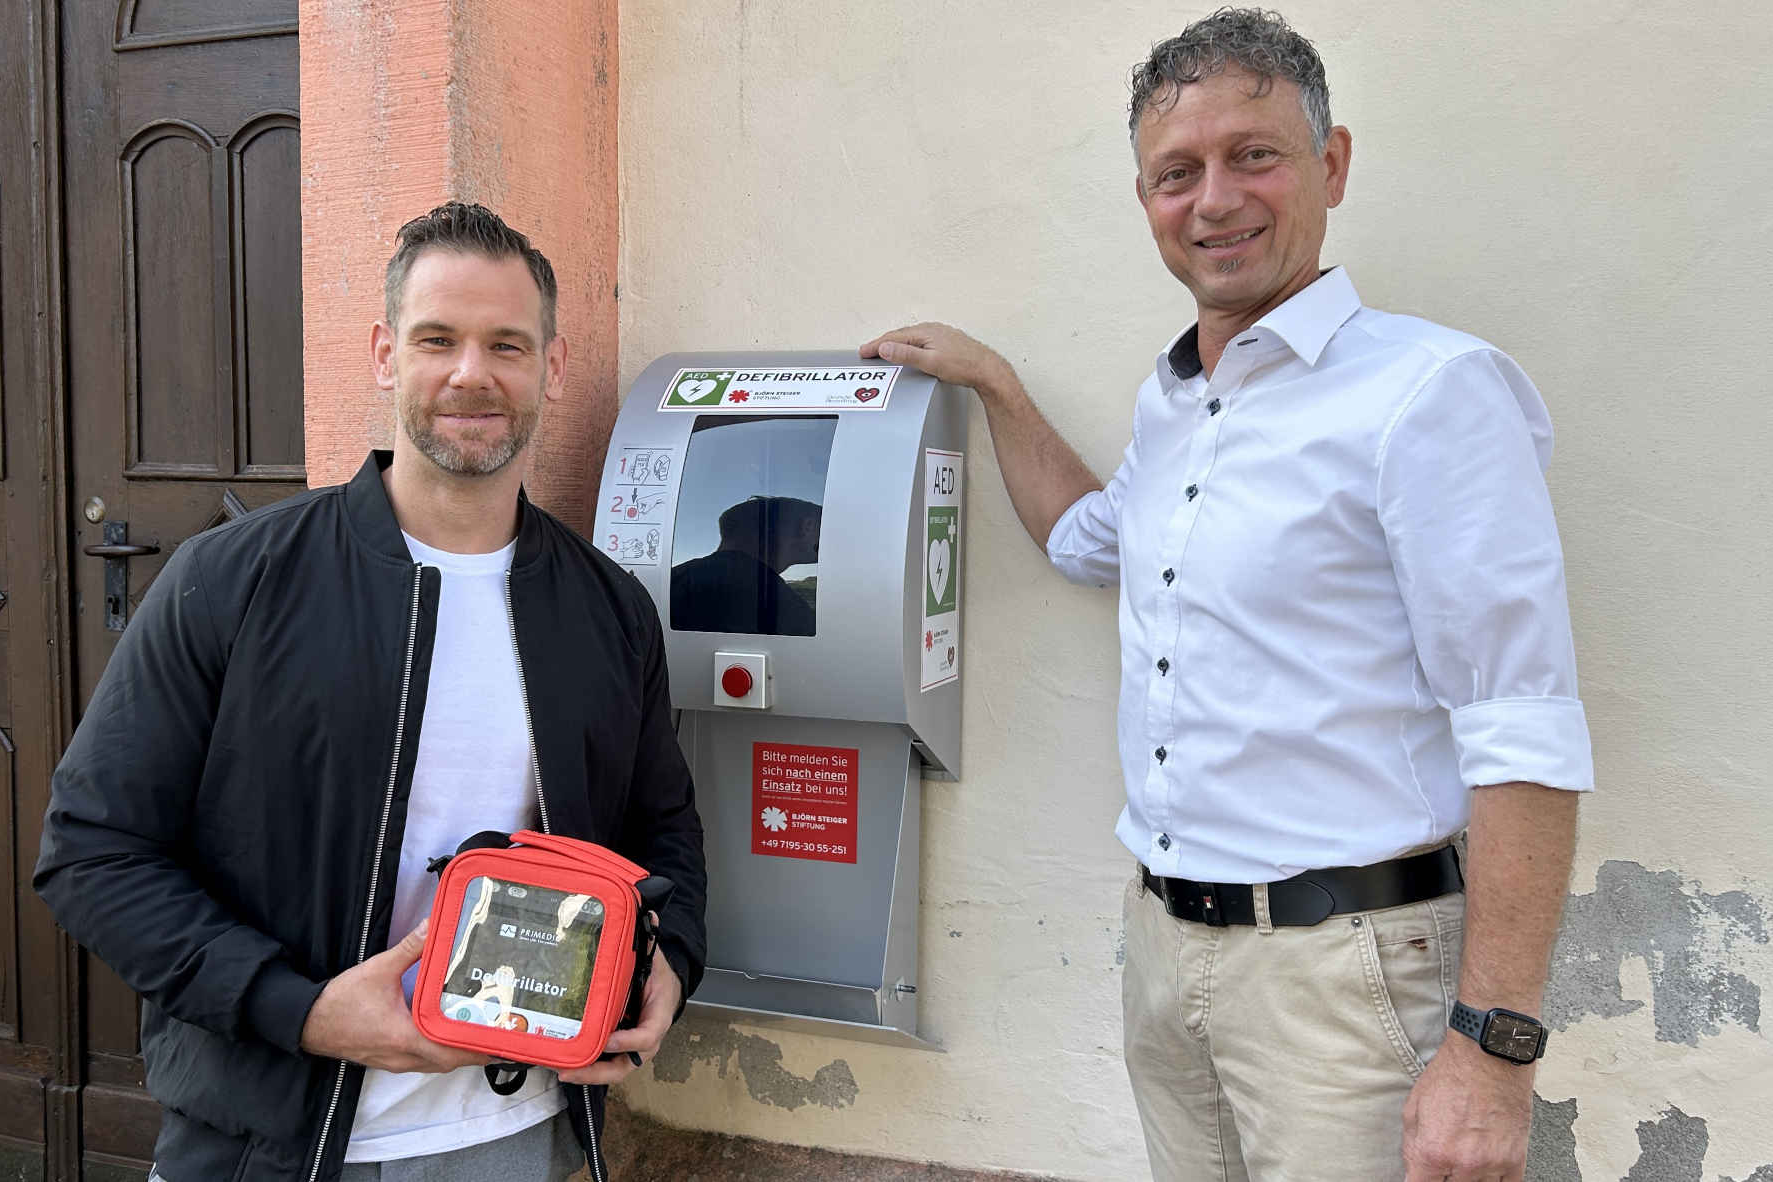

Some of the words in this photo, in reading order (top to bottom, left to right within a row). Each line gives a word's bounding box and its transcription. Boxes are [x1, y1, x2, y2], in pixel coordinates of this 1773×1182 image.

[736, 372, 887, 382] DEFIBRILLATOR
[619, 457, 627, 474] 1
[933, 465, 955, 495] AED
[610, 495, 624, 513] 2
[606, 534, 619, 552] 3
[762, 750, 787, 763] Bitte
[790, 754, 829, 766] melden
[831, 756, 848, 767] Sie
[762, 765, 783, 776] sich
[785, 768, 812, 779] nach
[814, 770, 848, 782] einem
[762, 779, 801, 792] Einsatz
[805, 783, 822, 794] bei
[825, 786, 847, 796] uns!
[791, 813, 816, 821] BJÖRN
[817, 816, 847, 824] STEIGER
[791, 821, 826, 830] STIFTUNG
[761, 839, 779, 848] +49
[780, 840, 815, 851] 7195-30
[817, 843, 847, 855] 55-251
[471, 967, 567, 997] Derillator
